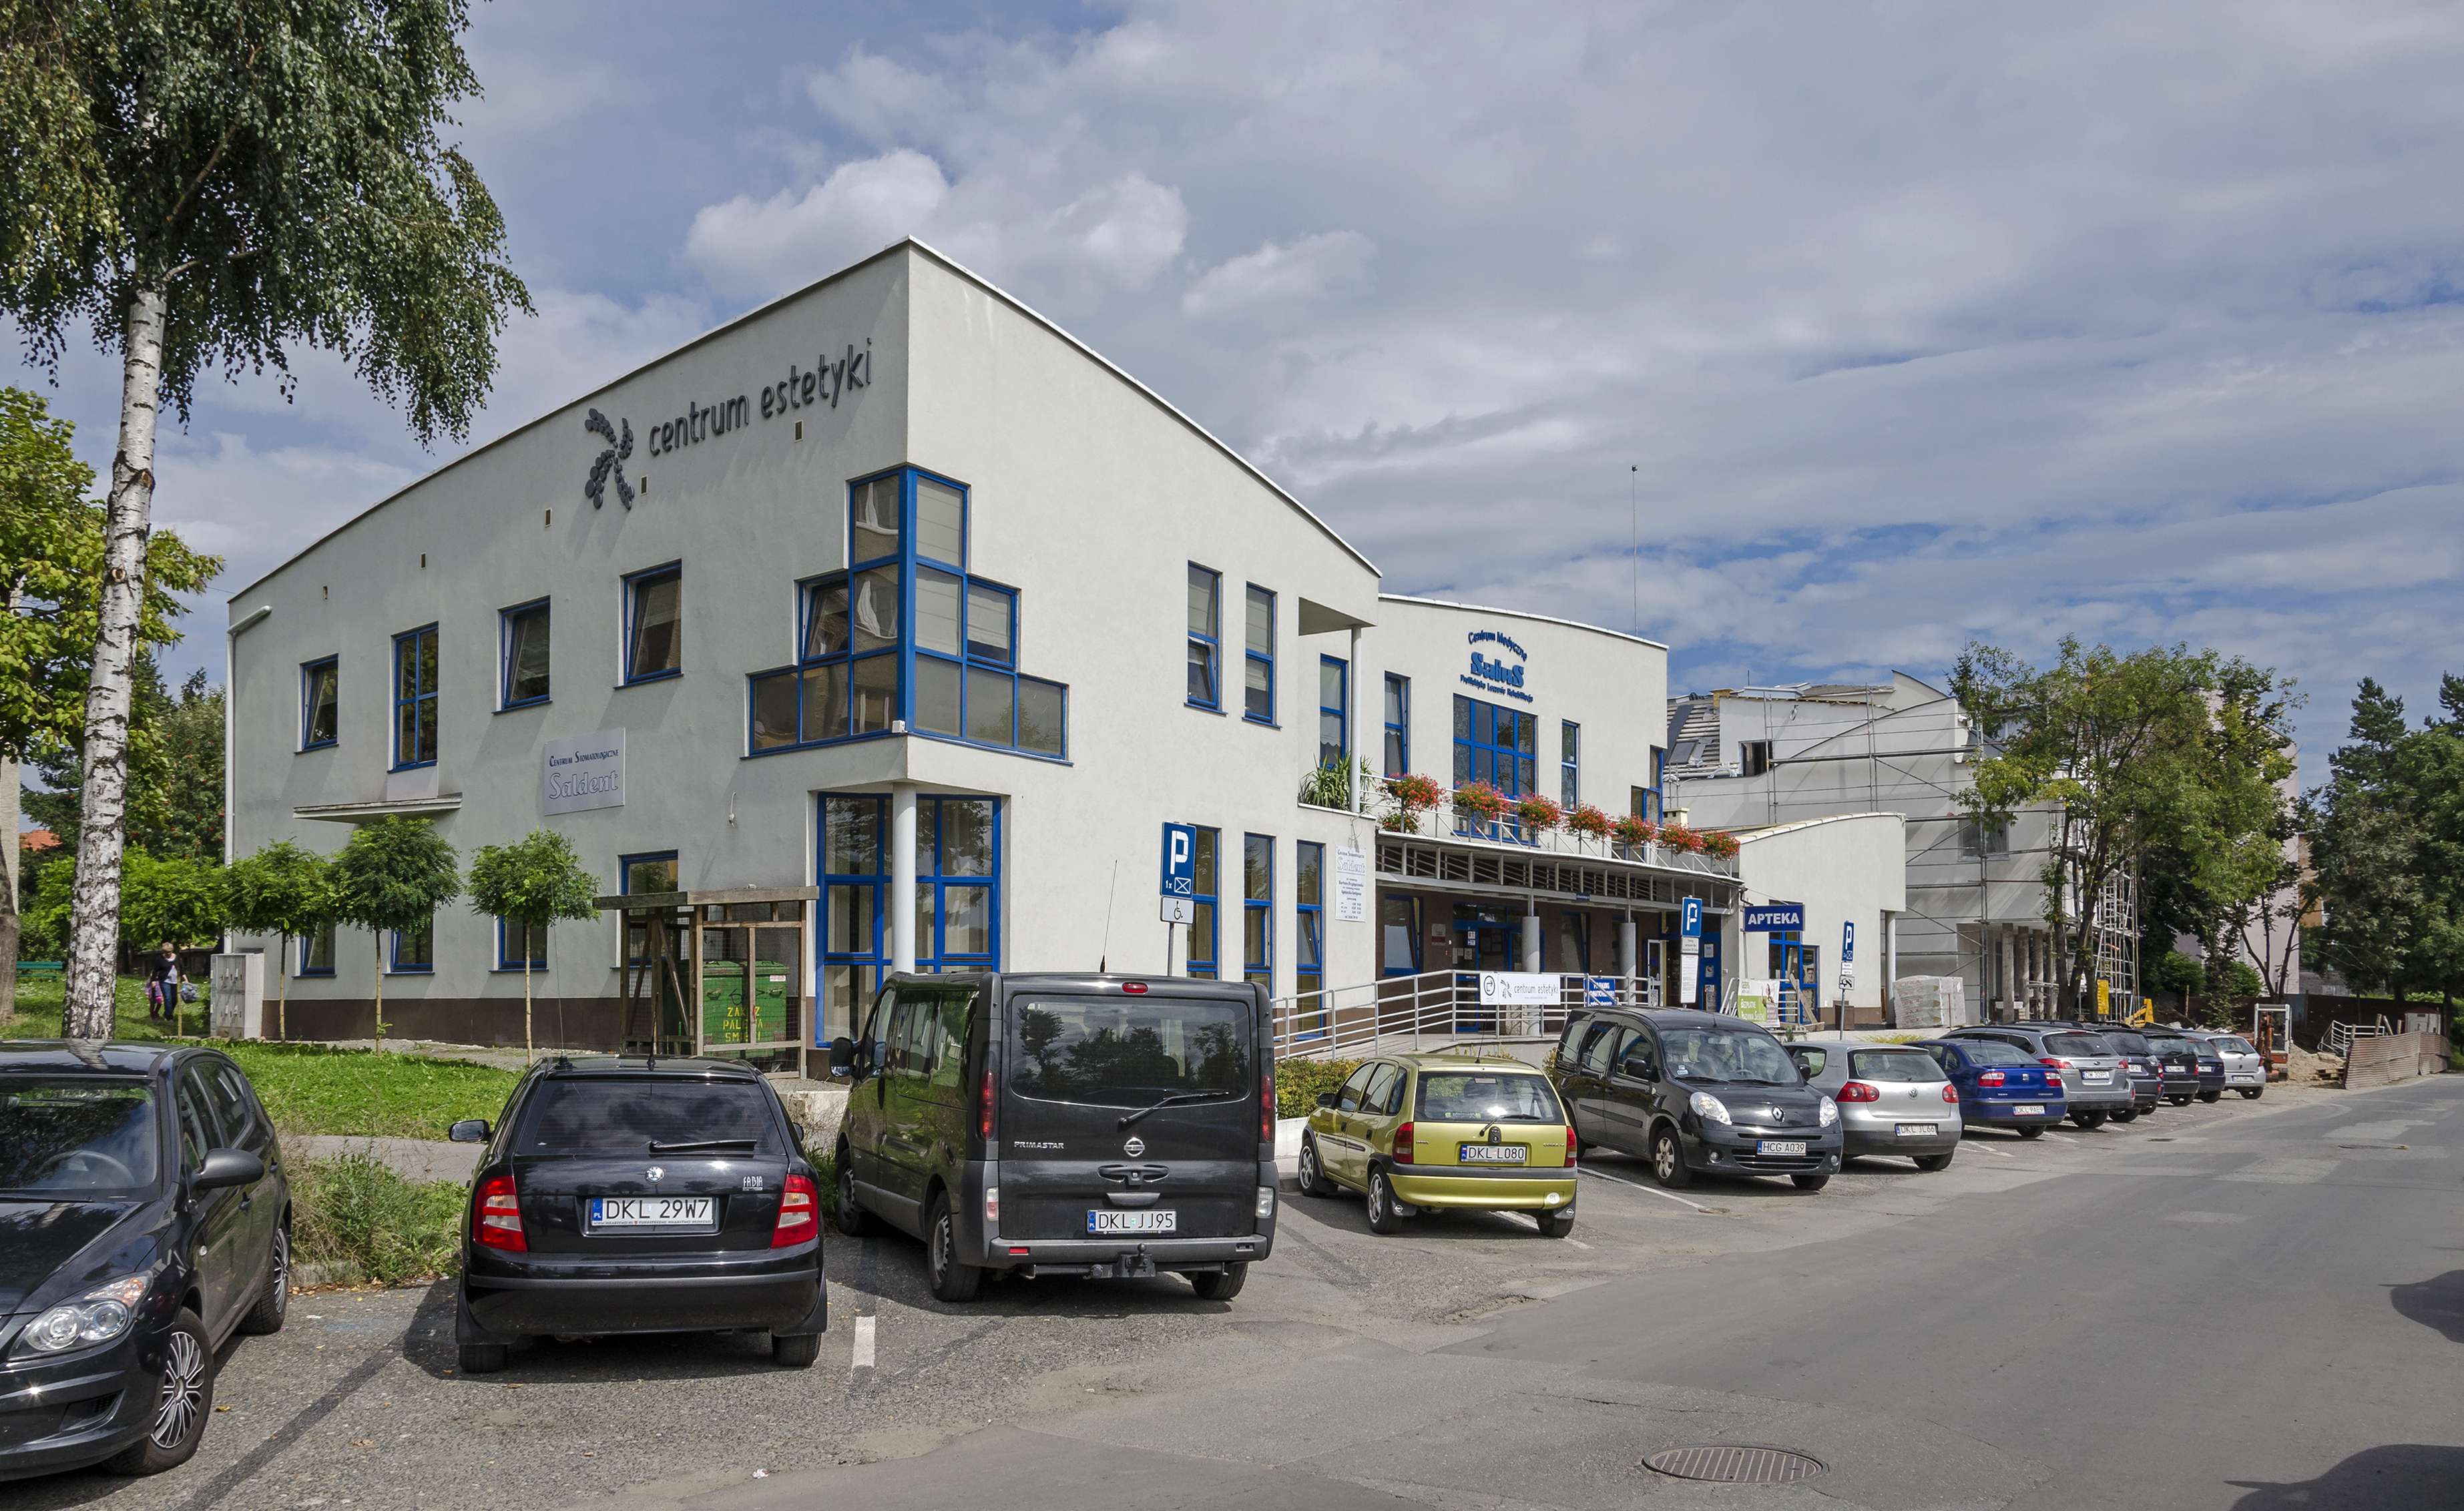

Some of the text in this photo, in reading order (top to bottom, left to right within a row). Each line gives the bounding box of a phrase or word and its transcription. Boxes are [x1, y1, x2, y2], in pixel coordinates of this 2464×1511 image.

[650, 338, 871, 456] centrum estetyki
[1468, 629, 1527, 663] Centrum Medyczne
[549, 770, 618, 800] Saldent
[1170, 830, 1189, 875] P
[1337, 856, 1365, 873] Saldent
[1166, 880, 1173, 889] 1x
[1686, 902, 1698, 931] P
[1748, 912, 1800, 925] APTEKA
[1845, 925, 1853, 950] P
[1514, 984, 1559, 996] centrum estetyki
[727, 1006, 760, 1017] ZAKZ
[723, 1018, 763, 1030] PALEIA
[725, 1031, 760, 1042] SMIEI
[1901, 1125, 1935, 1133] DKL JL66
[1014, 1141, 1065, 1149] PRIMASTAR
[1763, 1143, 1804, 1152] HCG A039
[1469, 1147, 1524, 1159] DKL L080
[743, 1175, 763, 1187] FABIA
[606, 1199, 710, 1219] DKL 29W7
[1099, 1213, 1173, 1229] DKL JJ95
